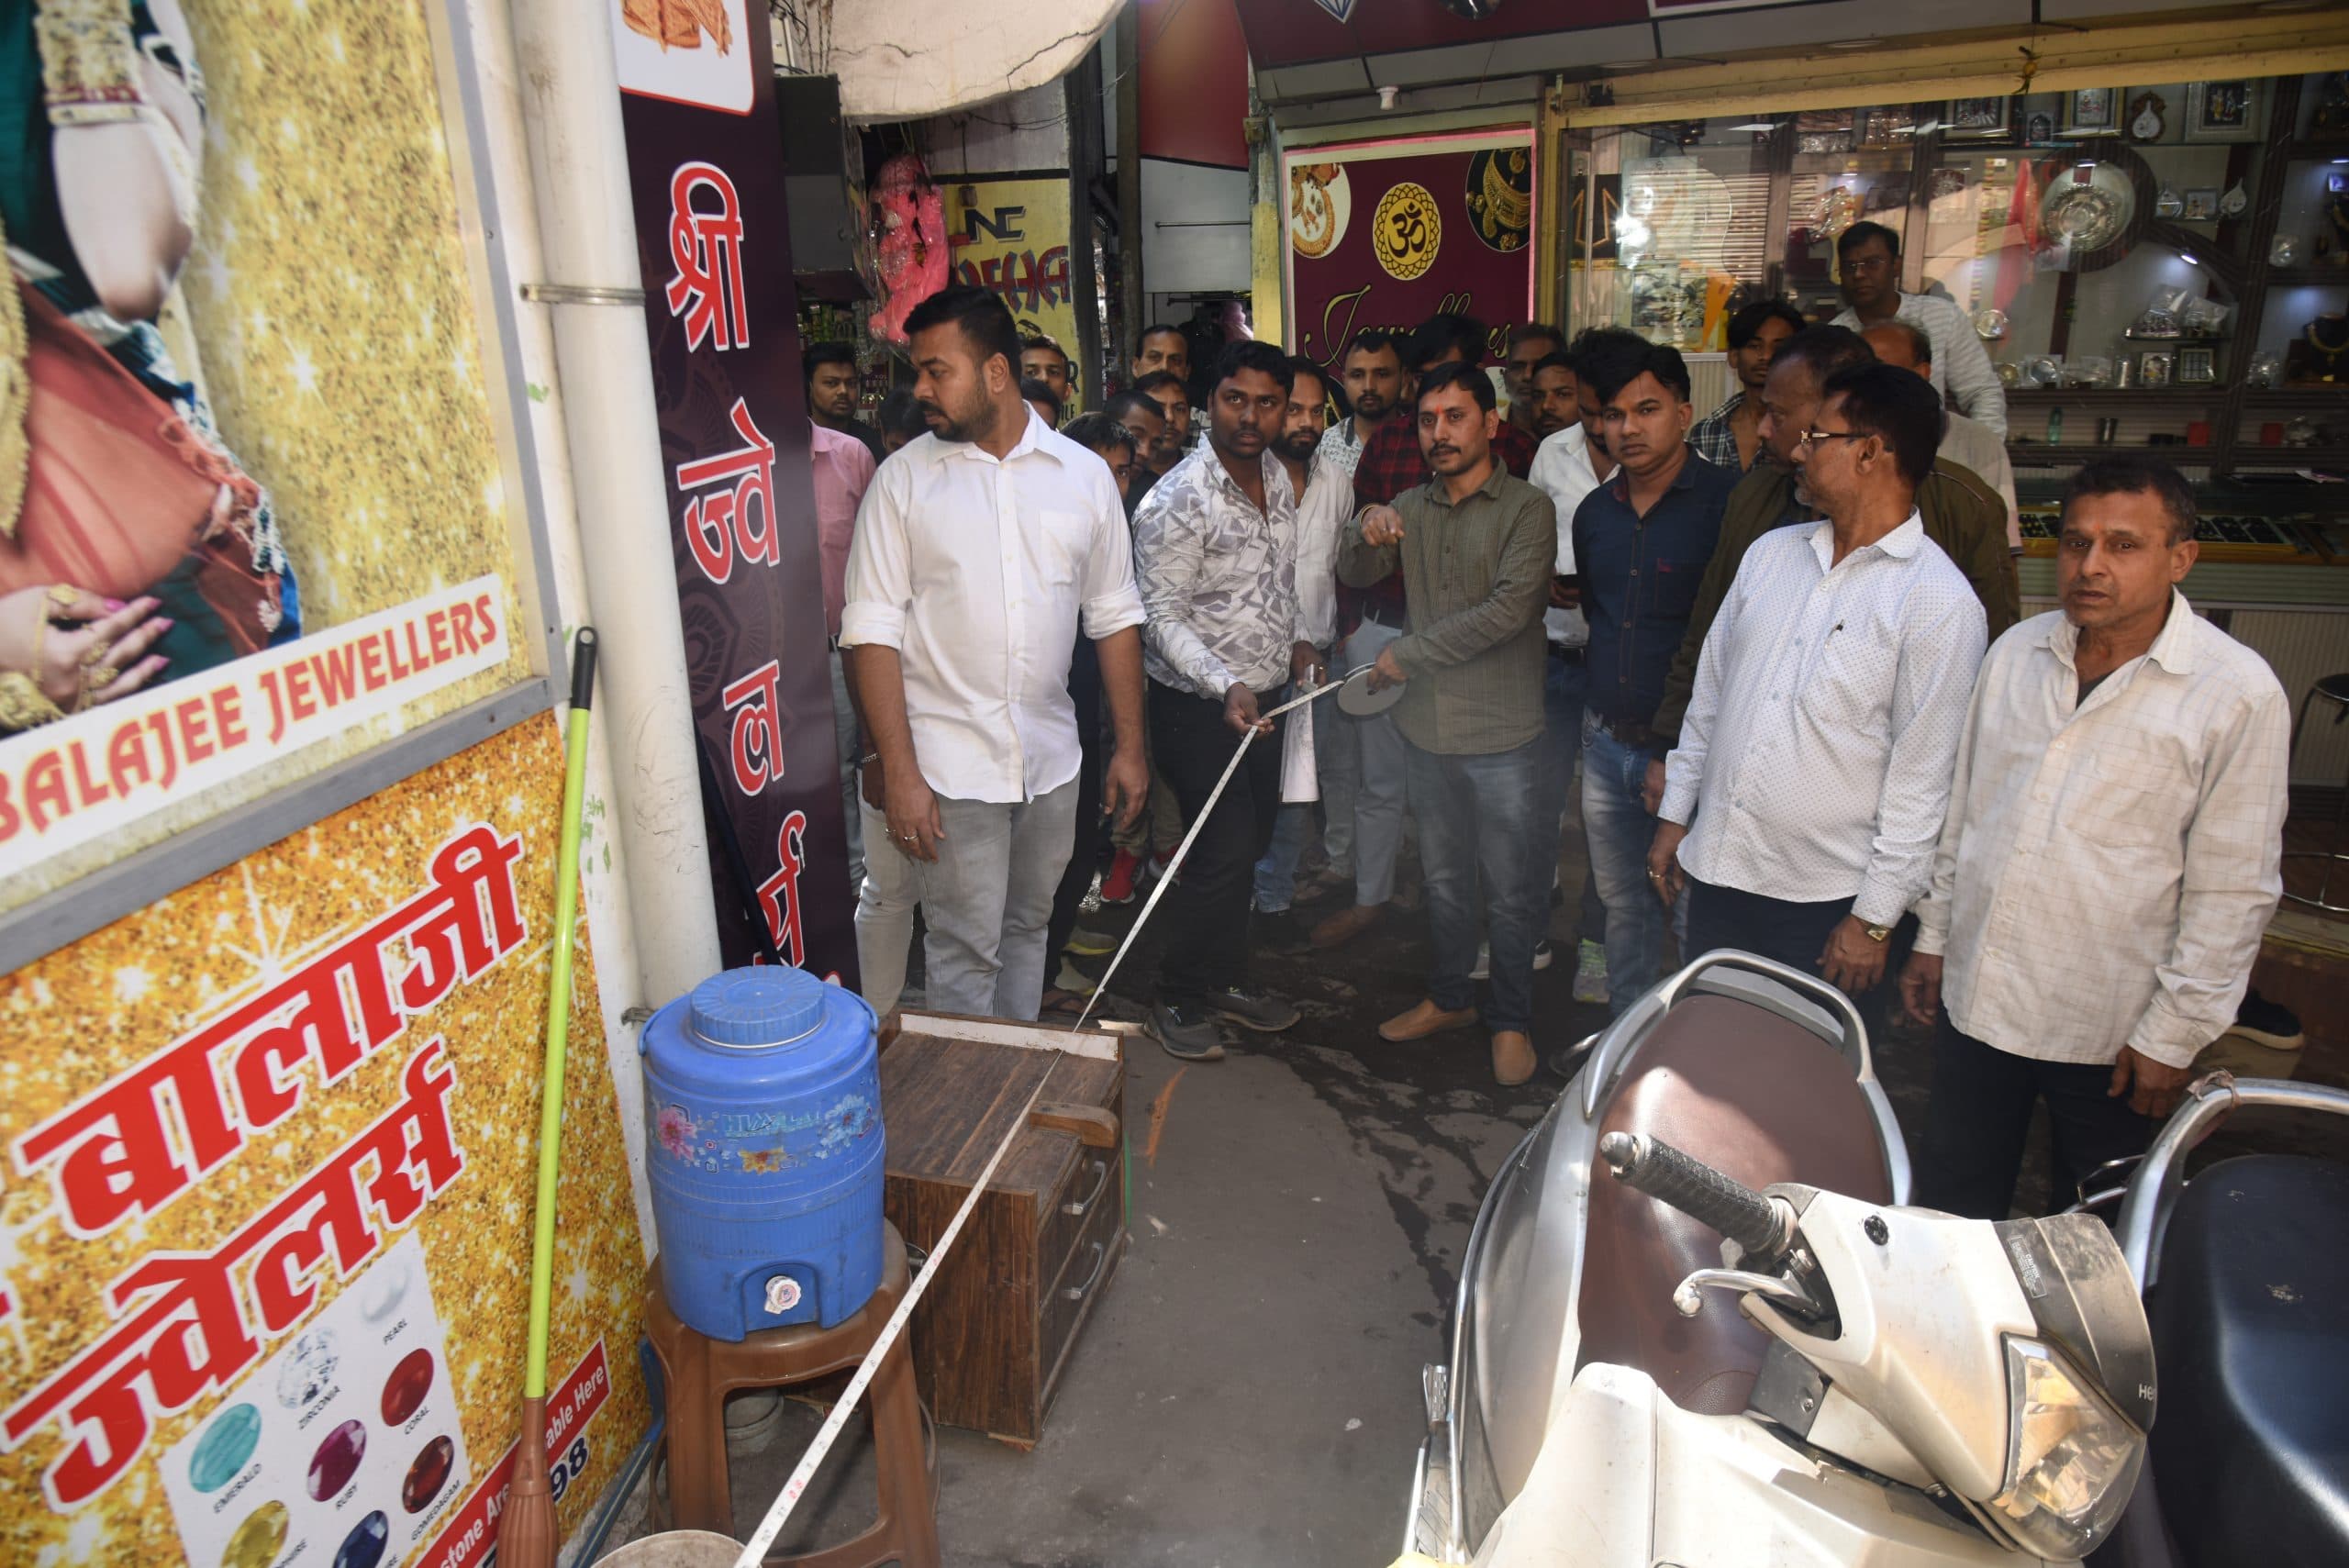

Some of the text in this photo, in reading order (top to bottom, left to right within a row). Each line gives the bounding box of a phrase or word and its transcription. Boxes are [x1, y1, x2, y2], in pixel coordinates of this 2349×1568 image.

[666, 161, 750, 351] श्री
[257, 593, 499, 747] JEWELLERS
[12, 822, 527, 1237] बालाजी
[2, 1035, 462, 1511] ज्वेलर्स
[404, 1406, 430, 1435] CORAL
[573, 1364, 605, 1412] Here
